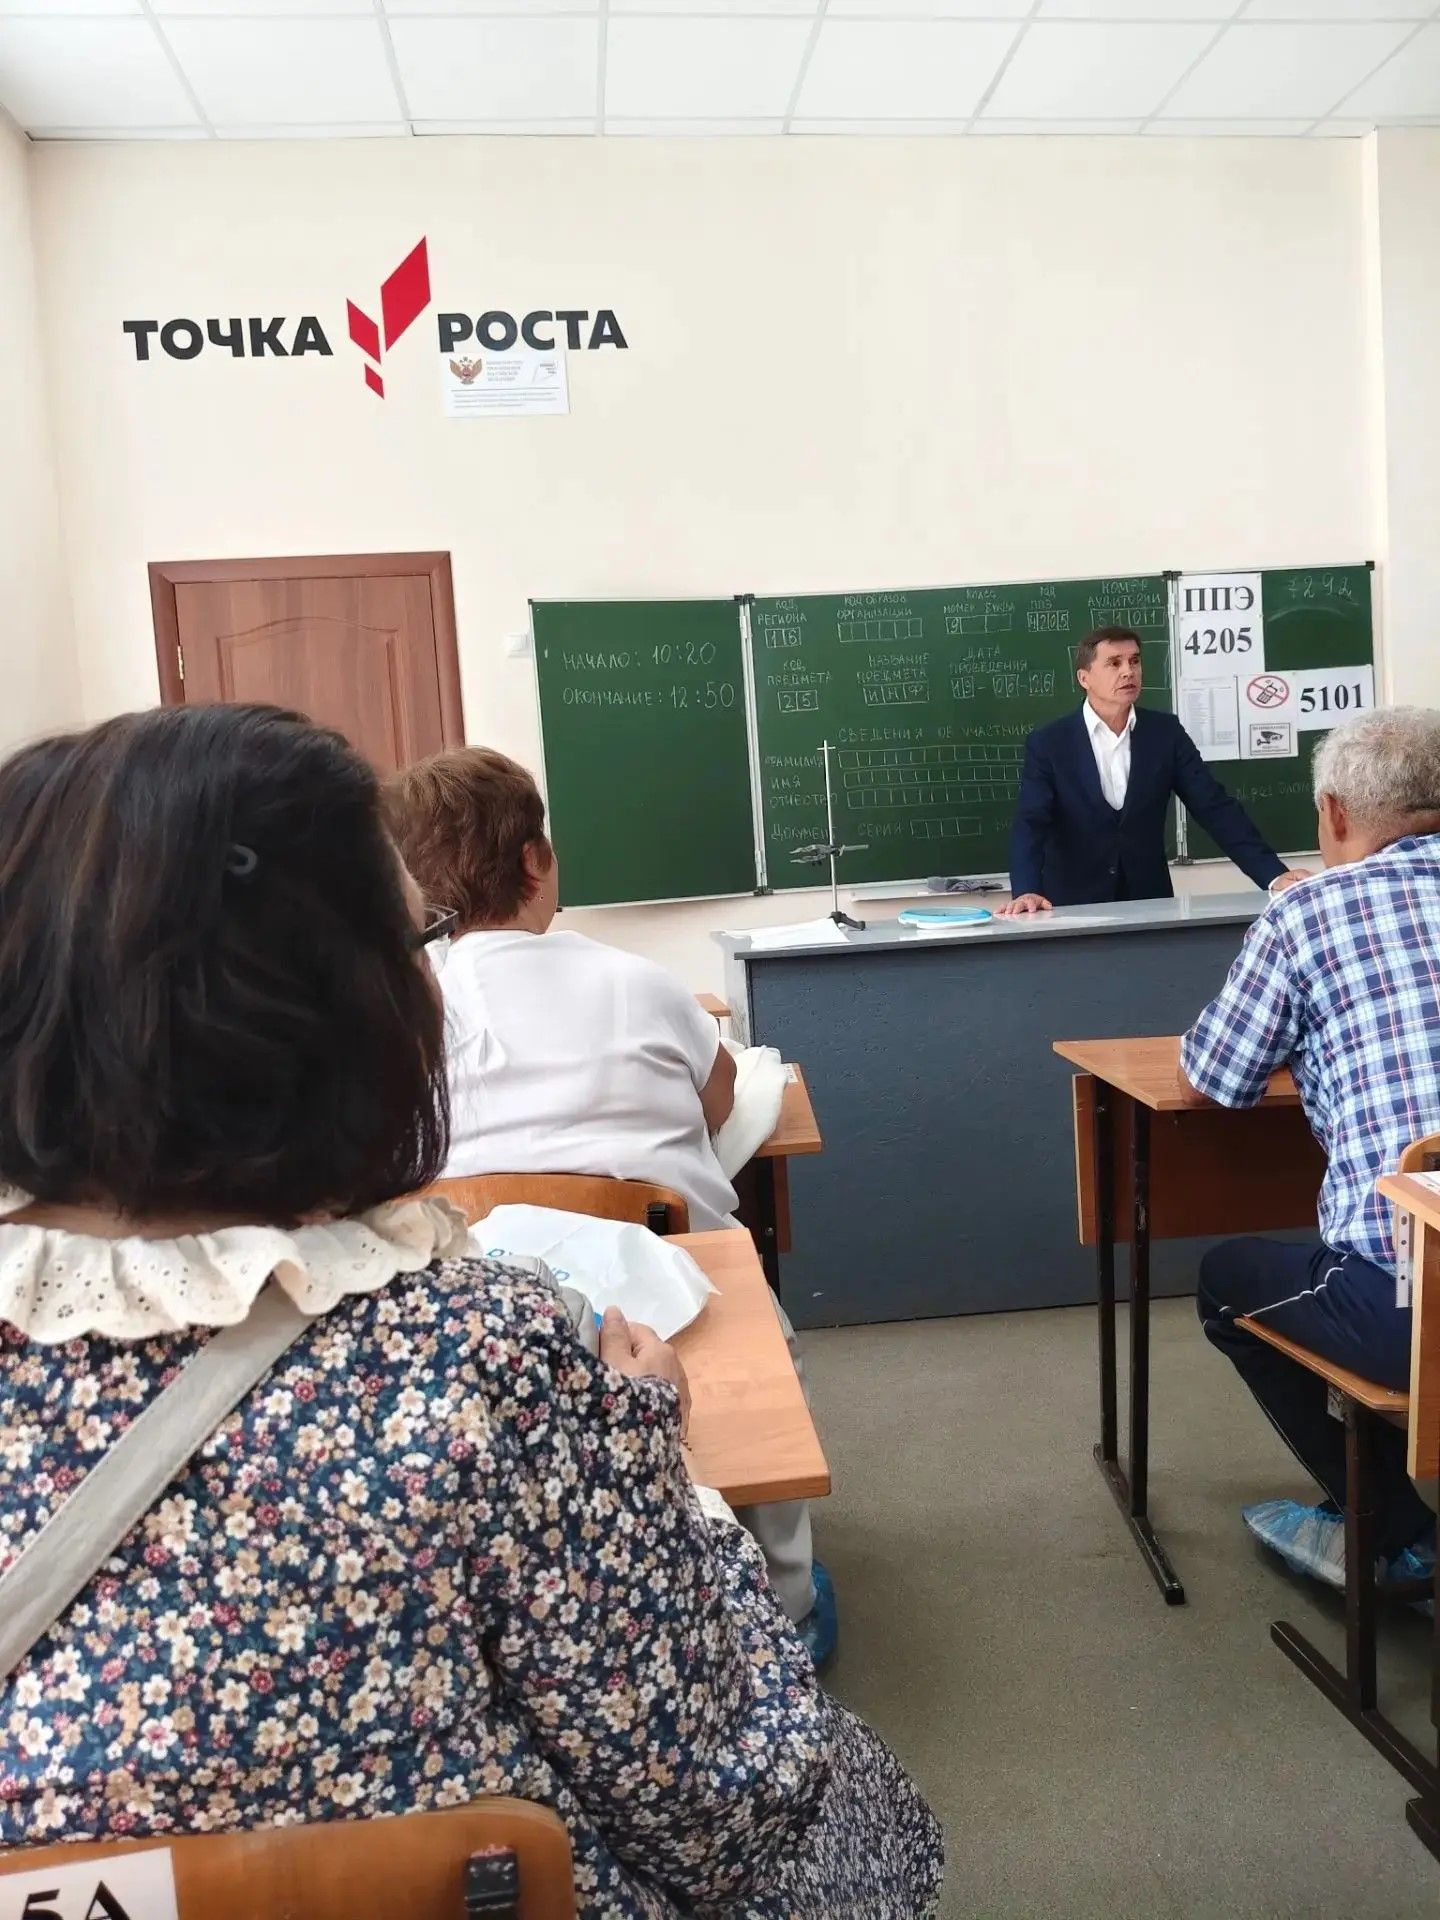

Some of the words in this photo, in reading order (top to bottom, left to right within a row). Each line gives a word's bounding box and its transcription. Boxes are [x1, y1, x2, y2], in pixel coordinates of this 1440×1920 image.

[123, 316, 334, 361] ТОЧКА
[437, 309, 629, 353] РОСТА
[776, 599, 798, 612] КОД
[1184, 586, 1255, 613] ППЭ
[757, 612, 808, 626] РЕГИОНА
[771, 629, 799, 649] 16
[1184, 626, 1253, 655] 4205
[652, 641, 716, 665] 10:20
[783, 693, 812, 709] 25
[1300, 682, 1366, 713] 5101
